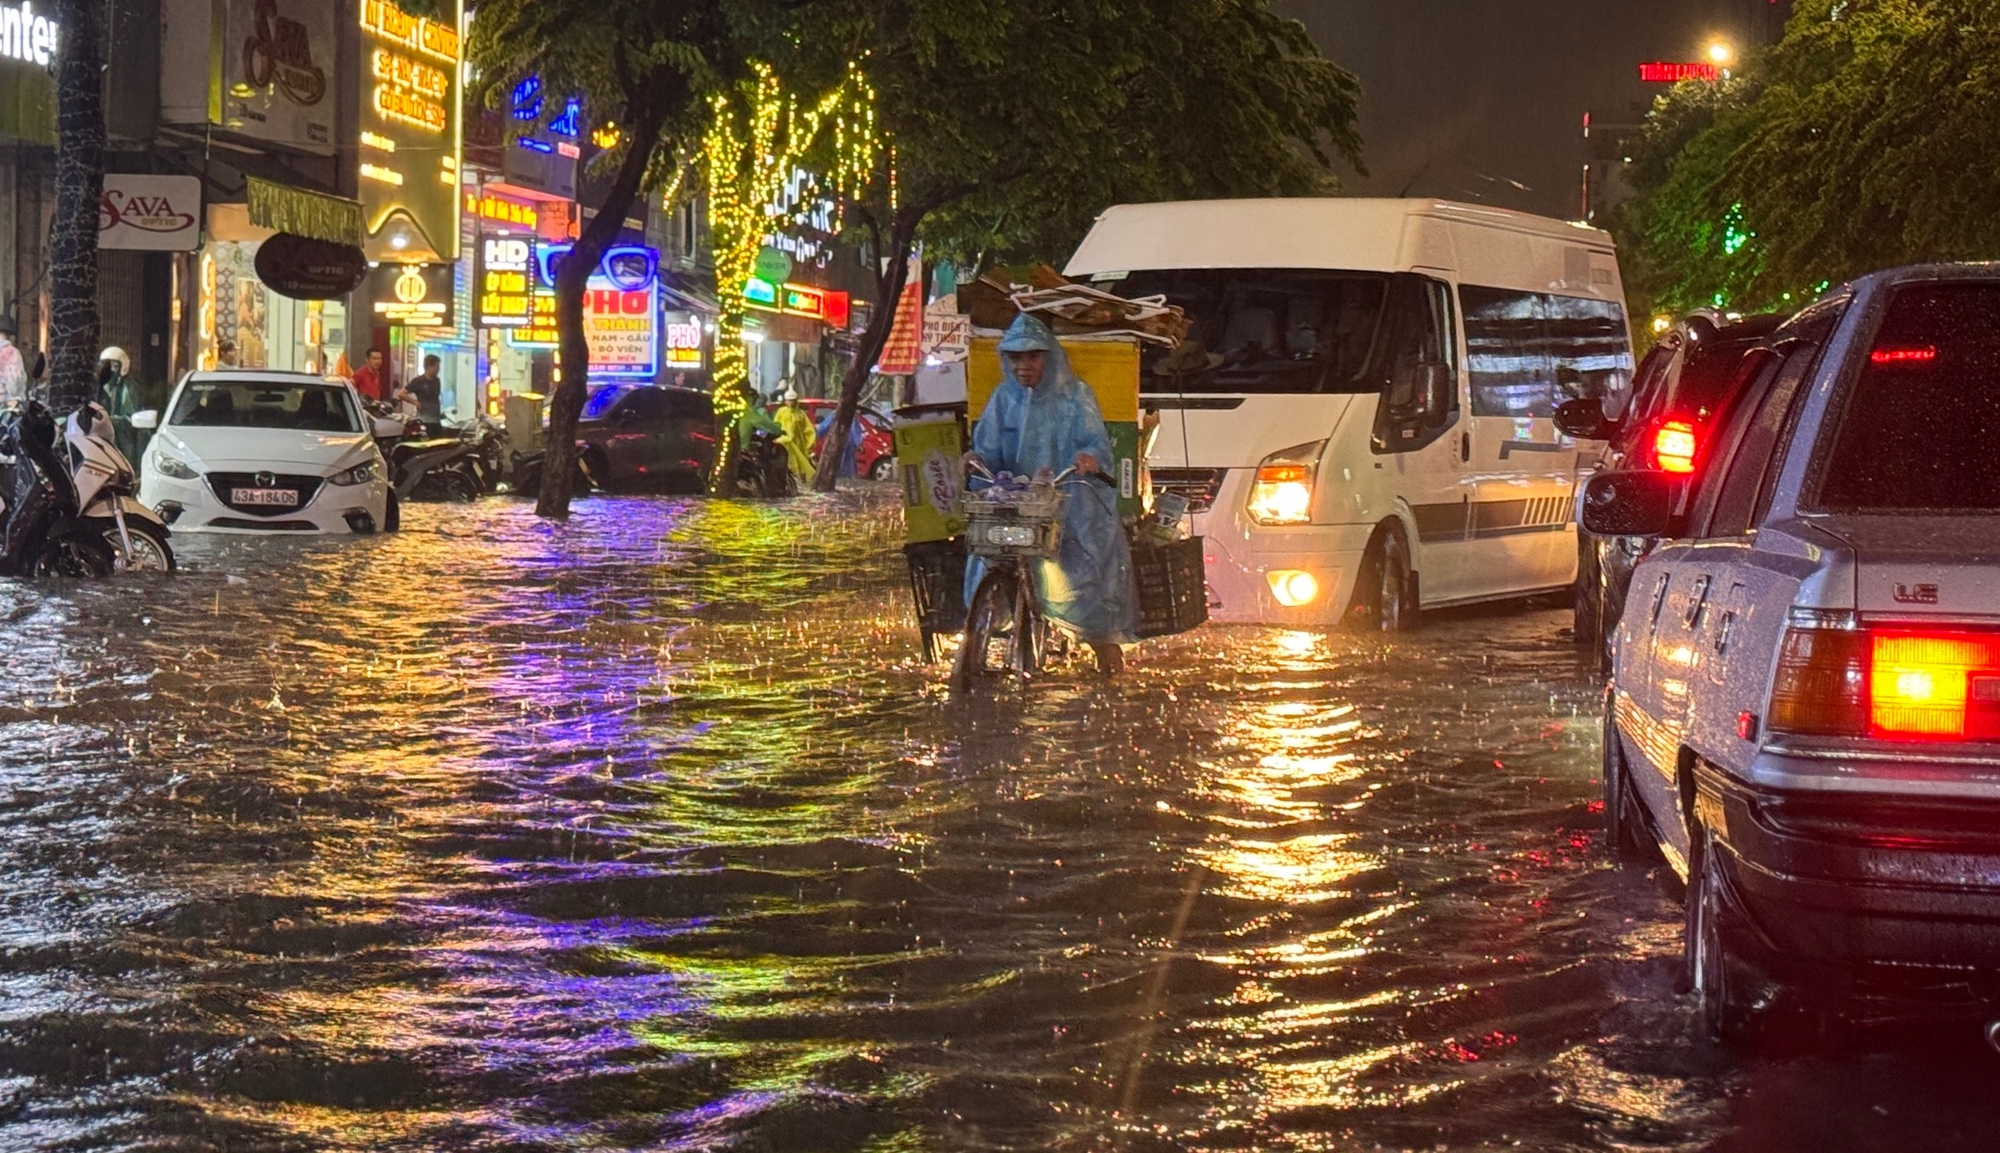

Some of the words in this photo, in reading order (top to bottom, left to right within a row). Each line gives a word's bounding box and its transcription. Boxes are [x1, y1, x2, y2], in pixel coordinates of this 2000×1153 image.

[99, 189, 176, 231] SAVA
[485, 240, 529, 263] HD
[1892, 582, 1939, 605] LE
